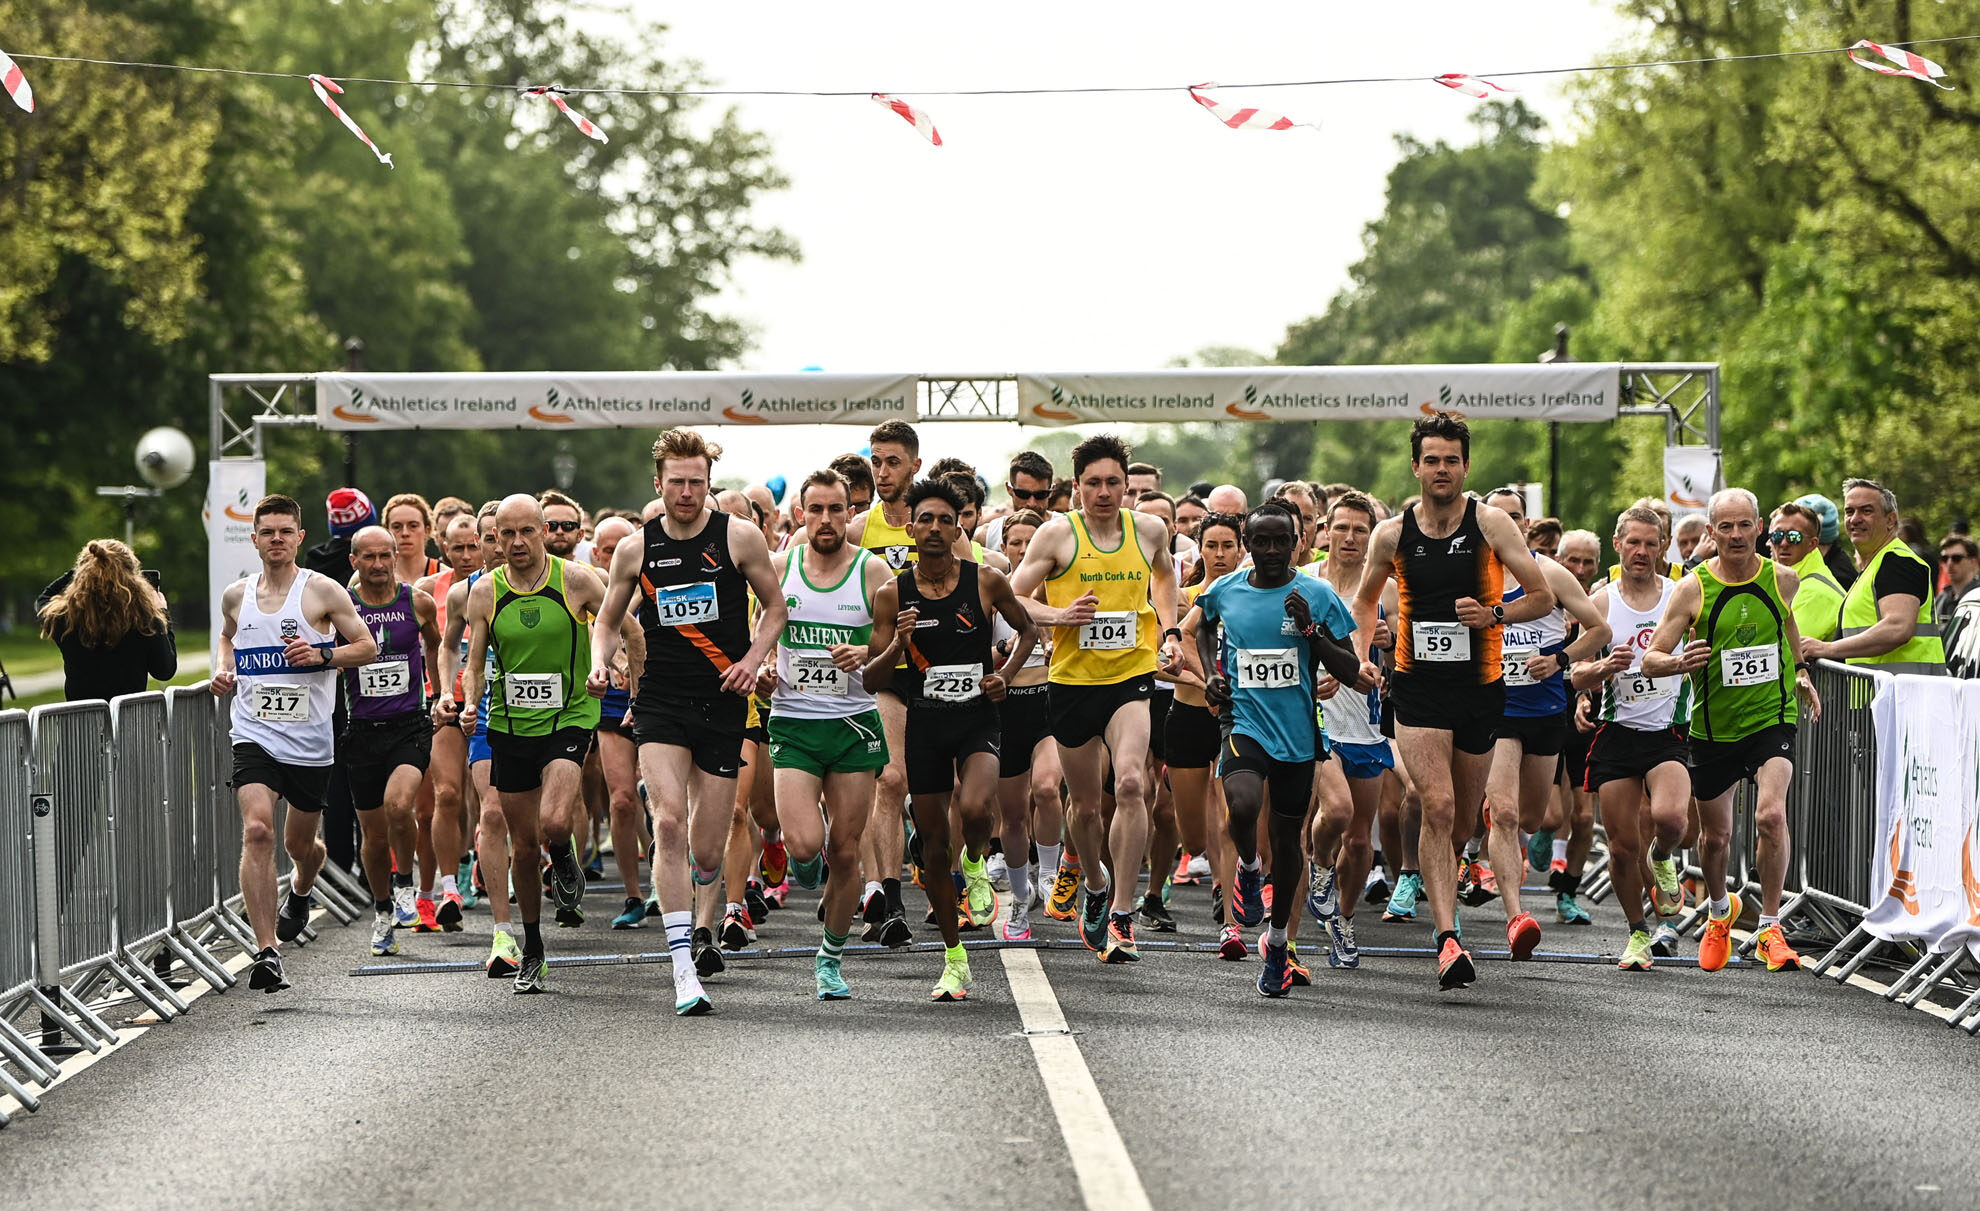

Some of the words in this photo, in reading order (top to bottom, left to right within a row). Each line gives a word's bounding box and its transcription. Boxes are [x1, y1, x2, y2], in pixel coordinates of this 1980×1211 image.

[368, 396, 447, 411] Athletics
[454, 397, 516, 411] Ireland
[564, 396, 642, 411] Athletics
[650, 397, 711, 412] Ireland
[757, 396, 837, 412] Athletics
[843, 396, 905, 411] Ireland
[1068, 393, 1146, 408] Athletics
[1153, 393, 1214, 408] Ireland
[1262, 392, 1340, 408] Athletics
[1347, 392, 1408, 408] Ireland
[1456, 391, 1535, 407] Athletics
[1542, 391, 1604, 406] Ireland
[1080, 573, 1102, 582] North
[1105, 571, 1125, 581] Cork
[1128, 571, 1142, 580] A.C
[676, 594, 688, 602] 5K
[663, 600, 712, 619] 1057
[837, 604, 861, 612] LEYDENS
[789, 625, 853, 646] RAHENY
[1089, 625, 1127, 640] 104
[1429, 627, 1440, 635] 5K
[1502, 630, 1542, 646] VALLEY
[1427, 636, 1452, 651] 59
[239, 651, 292, 669] DUNBOY
[1740, 651, 1752, 660] 5K
[808, 660, 819, 668] 5K
[1244, 663, 1294, 681] 1910
[1732, 658, 1770, 676] 261
[367, 673, 402, 689] 152
[798, 668, 838, 684] 244
[270, 688, 281, 696] 5K
[514, 685, 552, 700] 205
[933, 677, 974, 693] 228
[1009, 687, 1036, 695] NIKE
[1633, 677, 1657, 693] 61
[261, 695, 299, 711] 217
